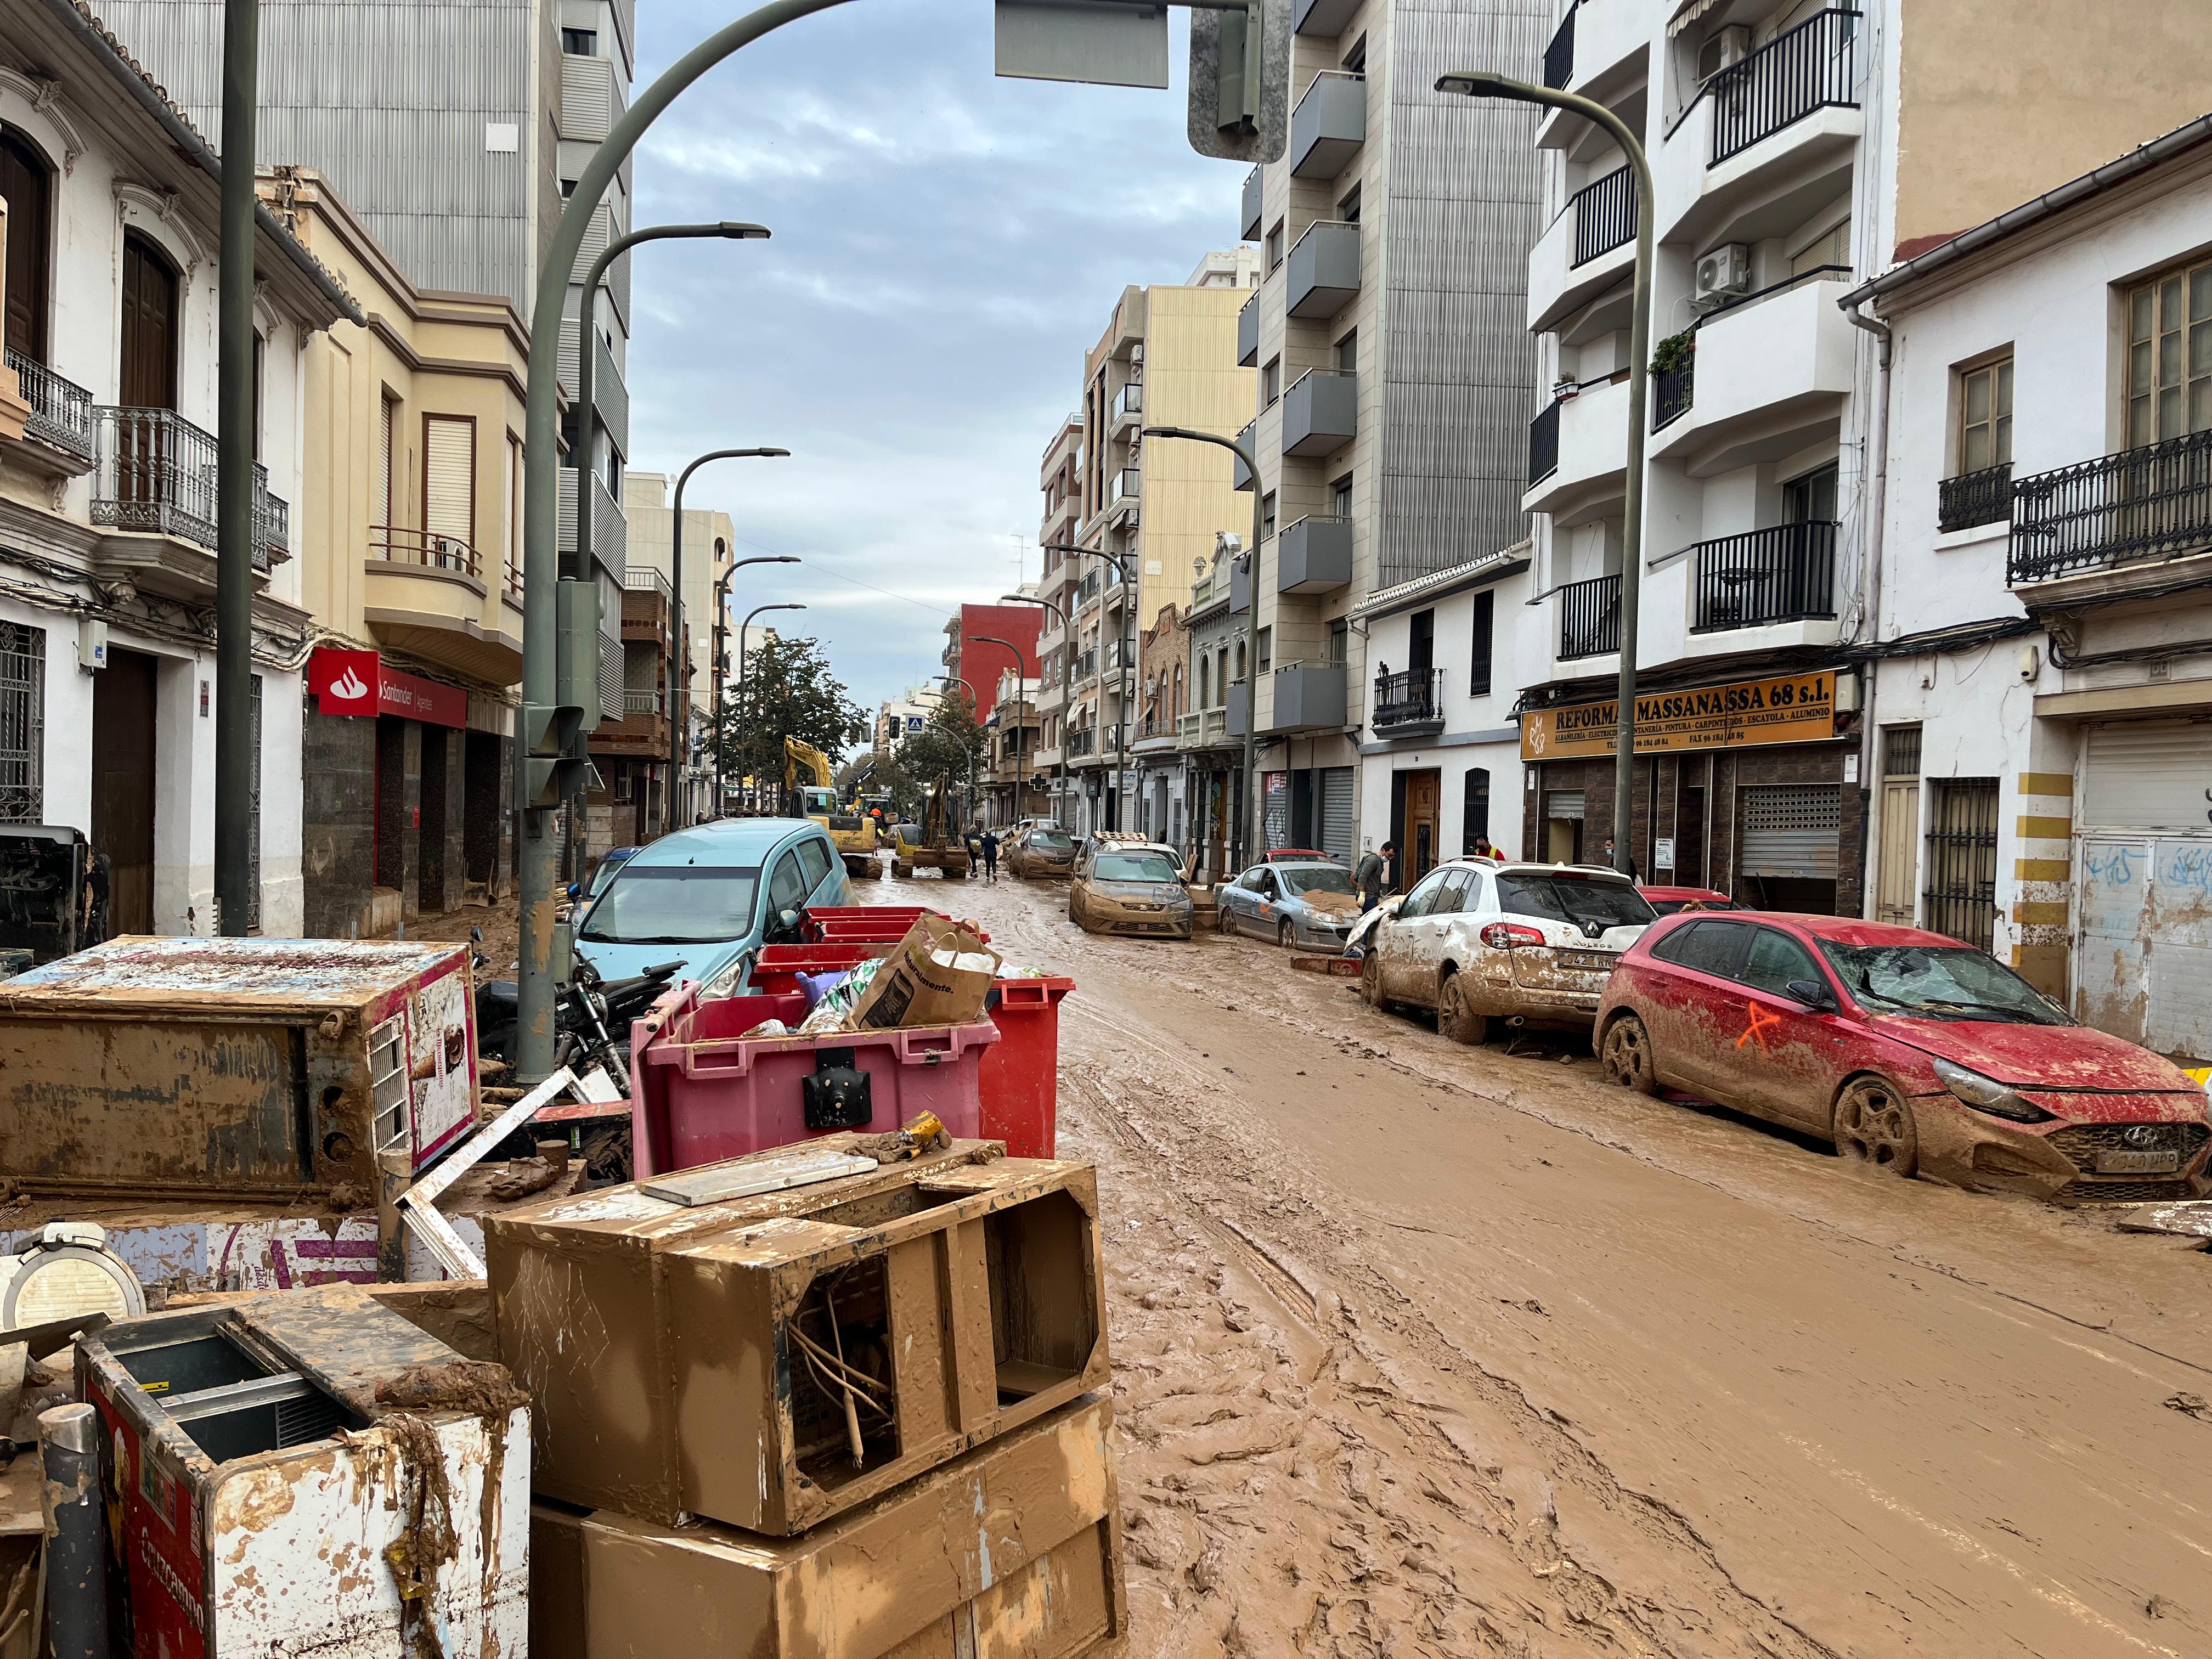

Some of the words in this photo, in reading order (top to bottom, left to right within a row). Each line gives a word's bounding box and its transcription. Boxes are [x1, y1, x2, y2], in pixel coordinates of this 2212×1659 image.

[383, 680, 413, 706] Santander
[417, 694, 433, 712] Agentes
[1637, 686, 1765, 721] MASSANASSA
[1770, 684, 1794, 706] 68
[1799, 678, 1830, 703] s.l.
[1555, 730, 1585, 741] ALBAÑILERÍA
[1589, 729, 1618, 738] ELECTRICID
[1633, 724, 1662, 734] NTANERÍA
[1665, 722, 1691, 731] PINTURA
[1747, 713, 1785, 725] ESCAYOLA
[1790, 708, 1830, 719] ALUMINIO
[1704, 735, 1711, 743] 96
[1736, 731, 1745, 740] 85
[904, 950, 953, 994] Naturalmente.
